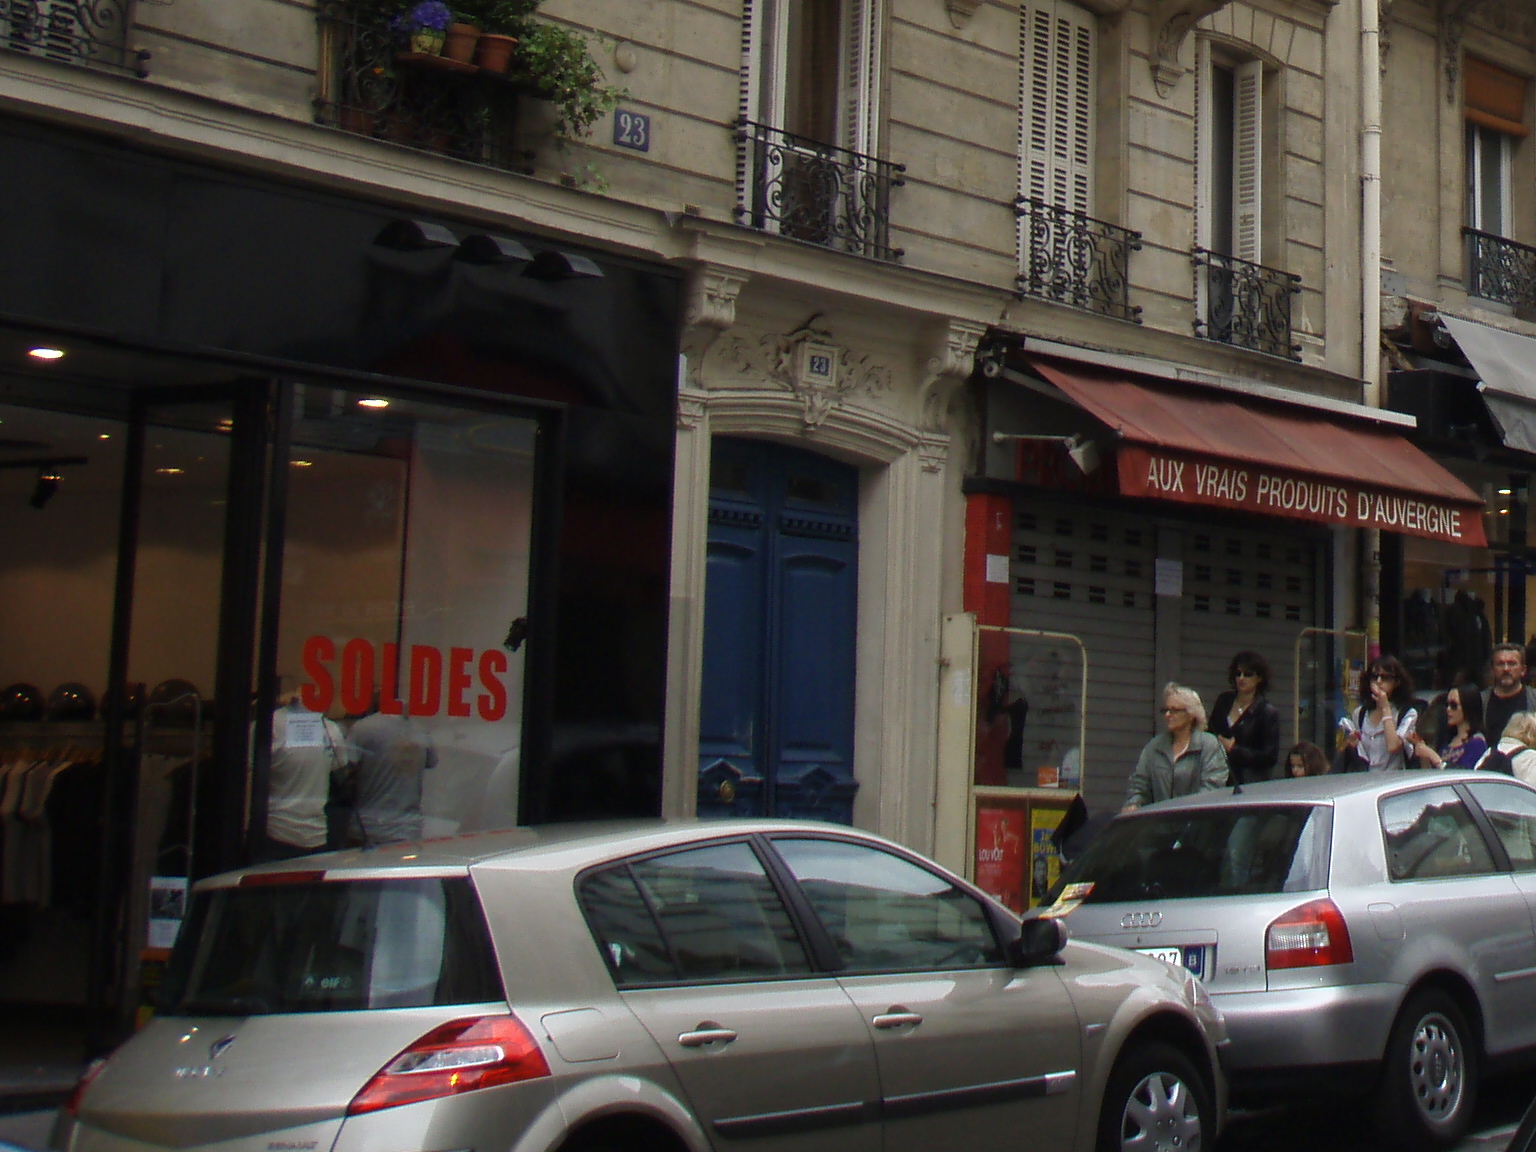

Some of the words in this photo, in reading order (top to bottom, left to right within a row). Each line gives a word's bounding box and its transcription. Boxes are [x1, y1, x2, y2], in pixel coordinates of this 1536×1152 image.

[619, 113, 646, 146] 23
[813, 357, 826, 372] 23
[1147, 457, 1184, 493] AUX
[1196, 464, 1248, 501] VRAIS
[1256, 475, 1347, 518] PRODUITS
[1358, 492, 1462, 538] D'AUVERGNE
[301, 635, 508, 722] SOLDES
